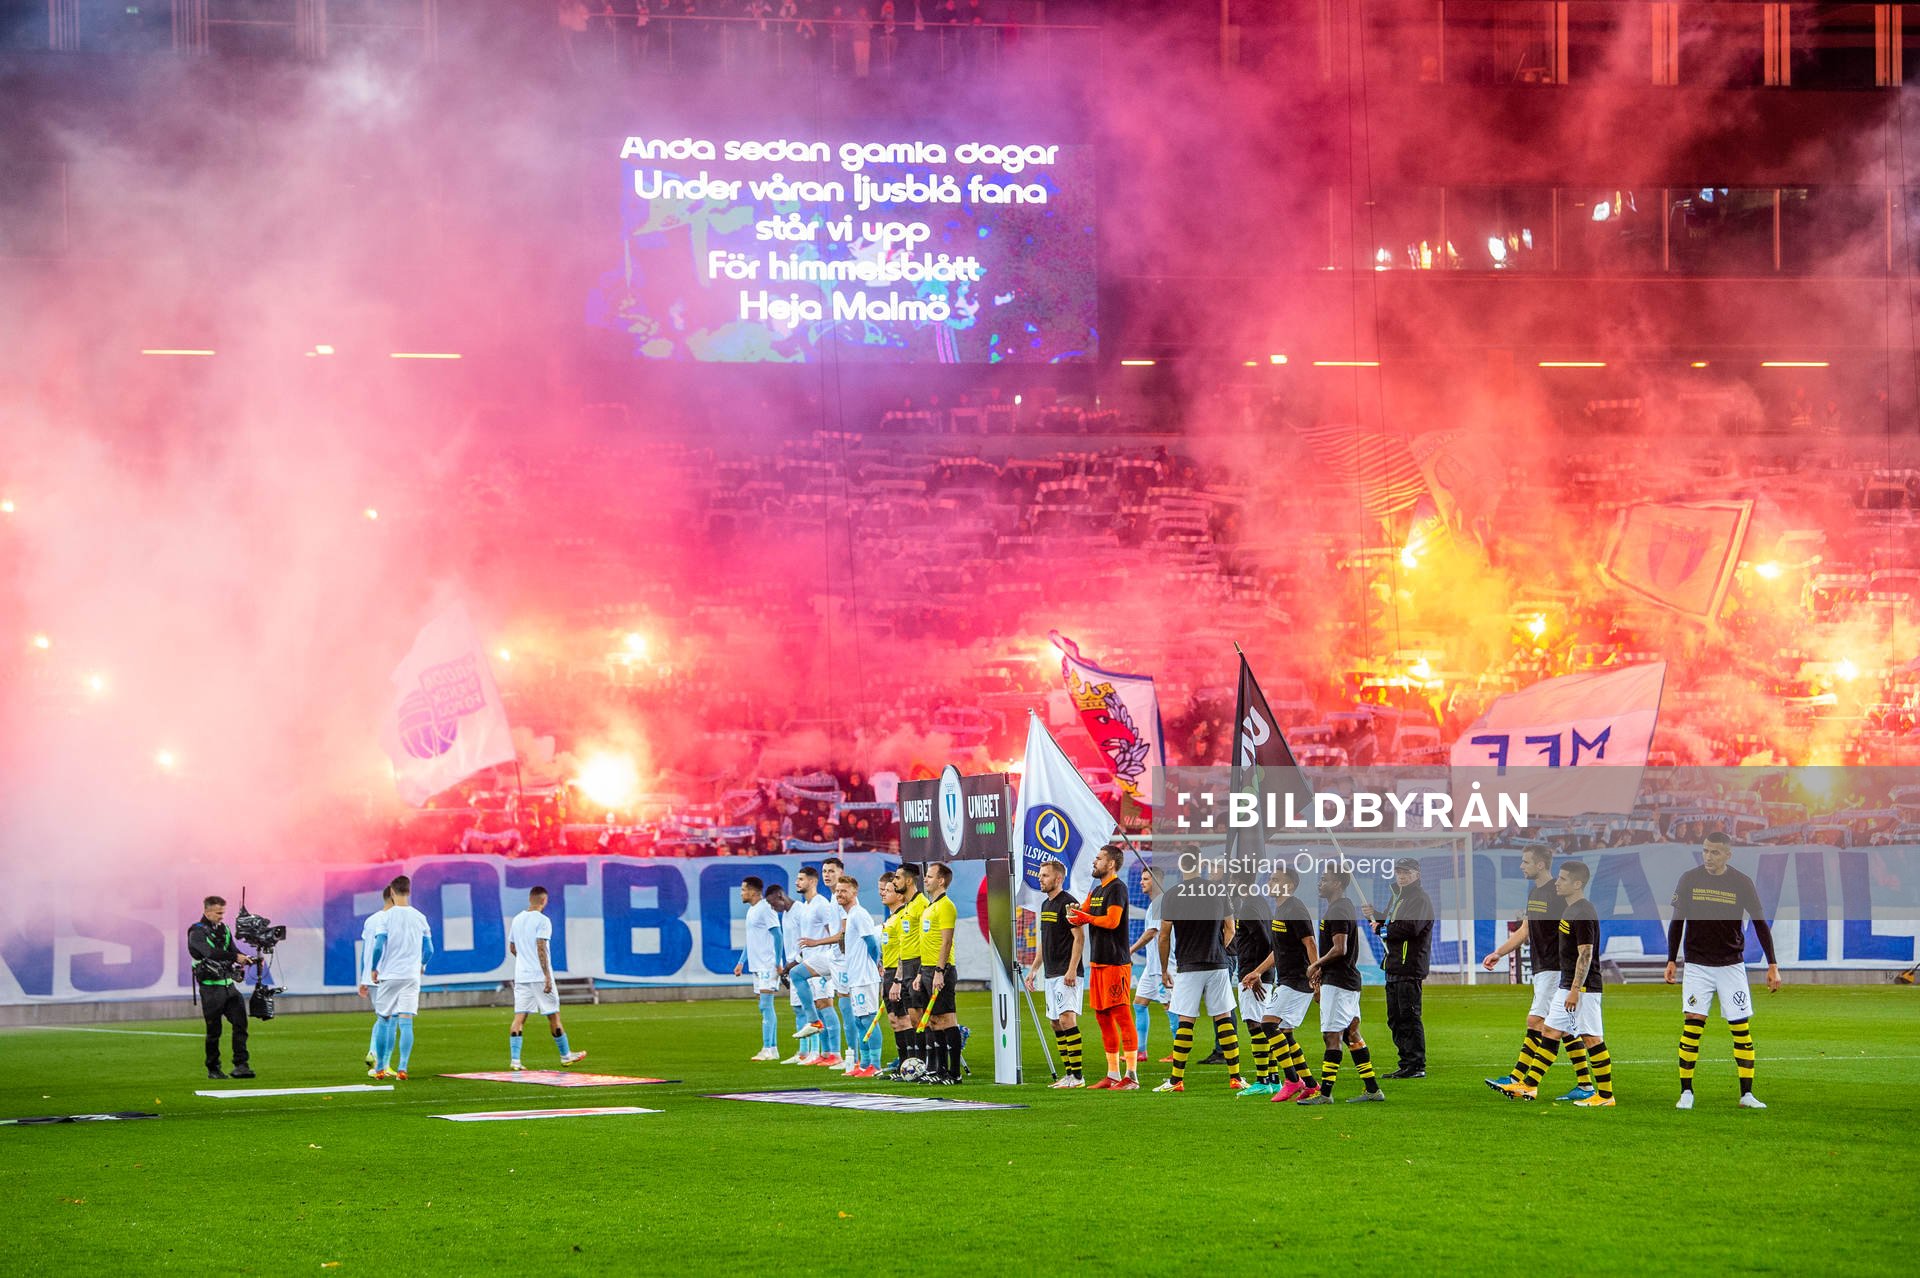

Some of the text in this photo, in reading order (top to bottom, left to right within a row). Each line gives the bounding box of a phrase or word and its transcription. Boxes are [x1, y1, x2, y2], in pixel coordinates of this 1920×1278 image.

[724, 139, 831, 161] sedan
[954, 142, 1059, 173] dagar
[634, 169, 1048, 211] Under våran ljusblå fana
[755, 212, 931, 250] står vi upp
[708, 250, 980, 282] För himmelsblått
[740, 290, 951, 329] Heja Malmö
[903, 799, 932, 823] UNIBET
[967, 793, 1000, 819] UNIBET
